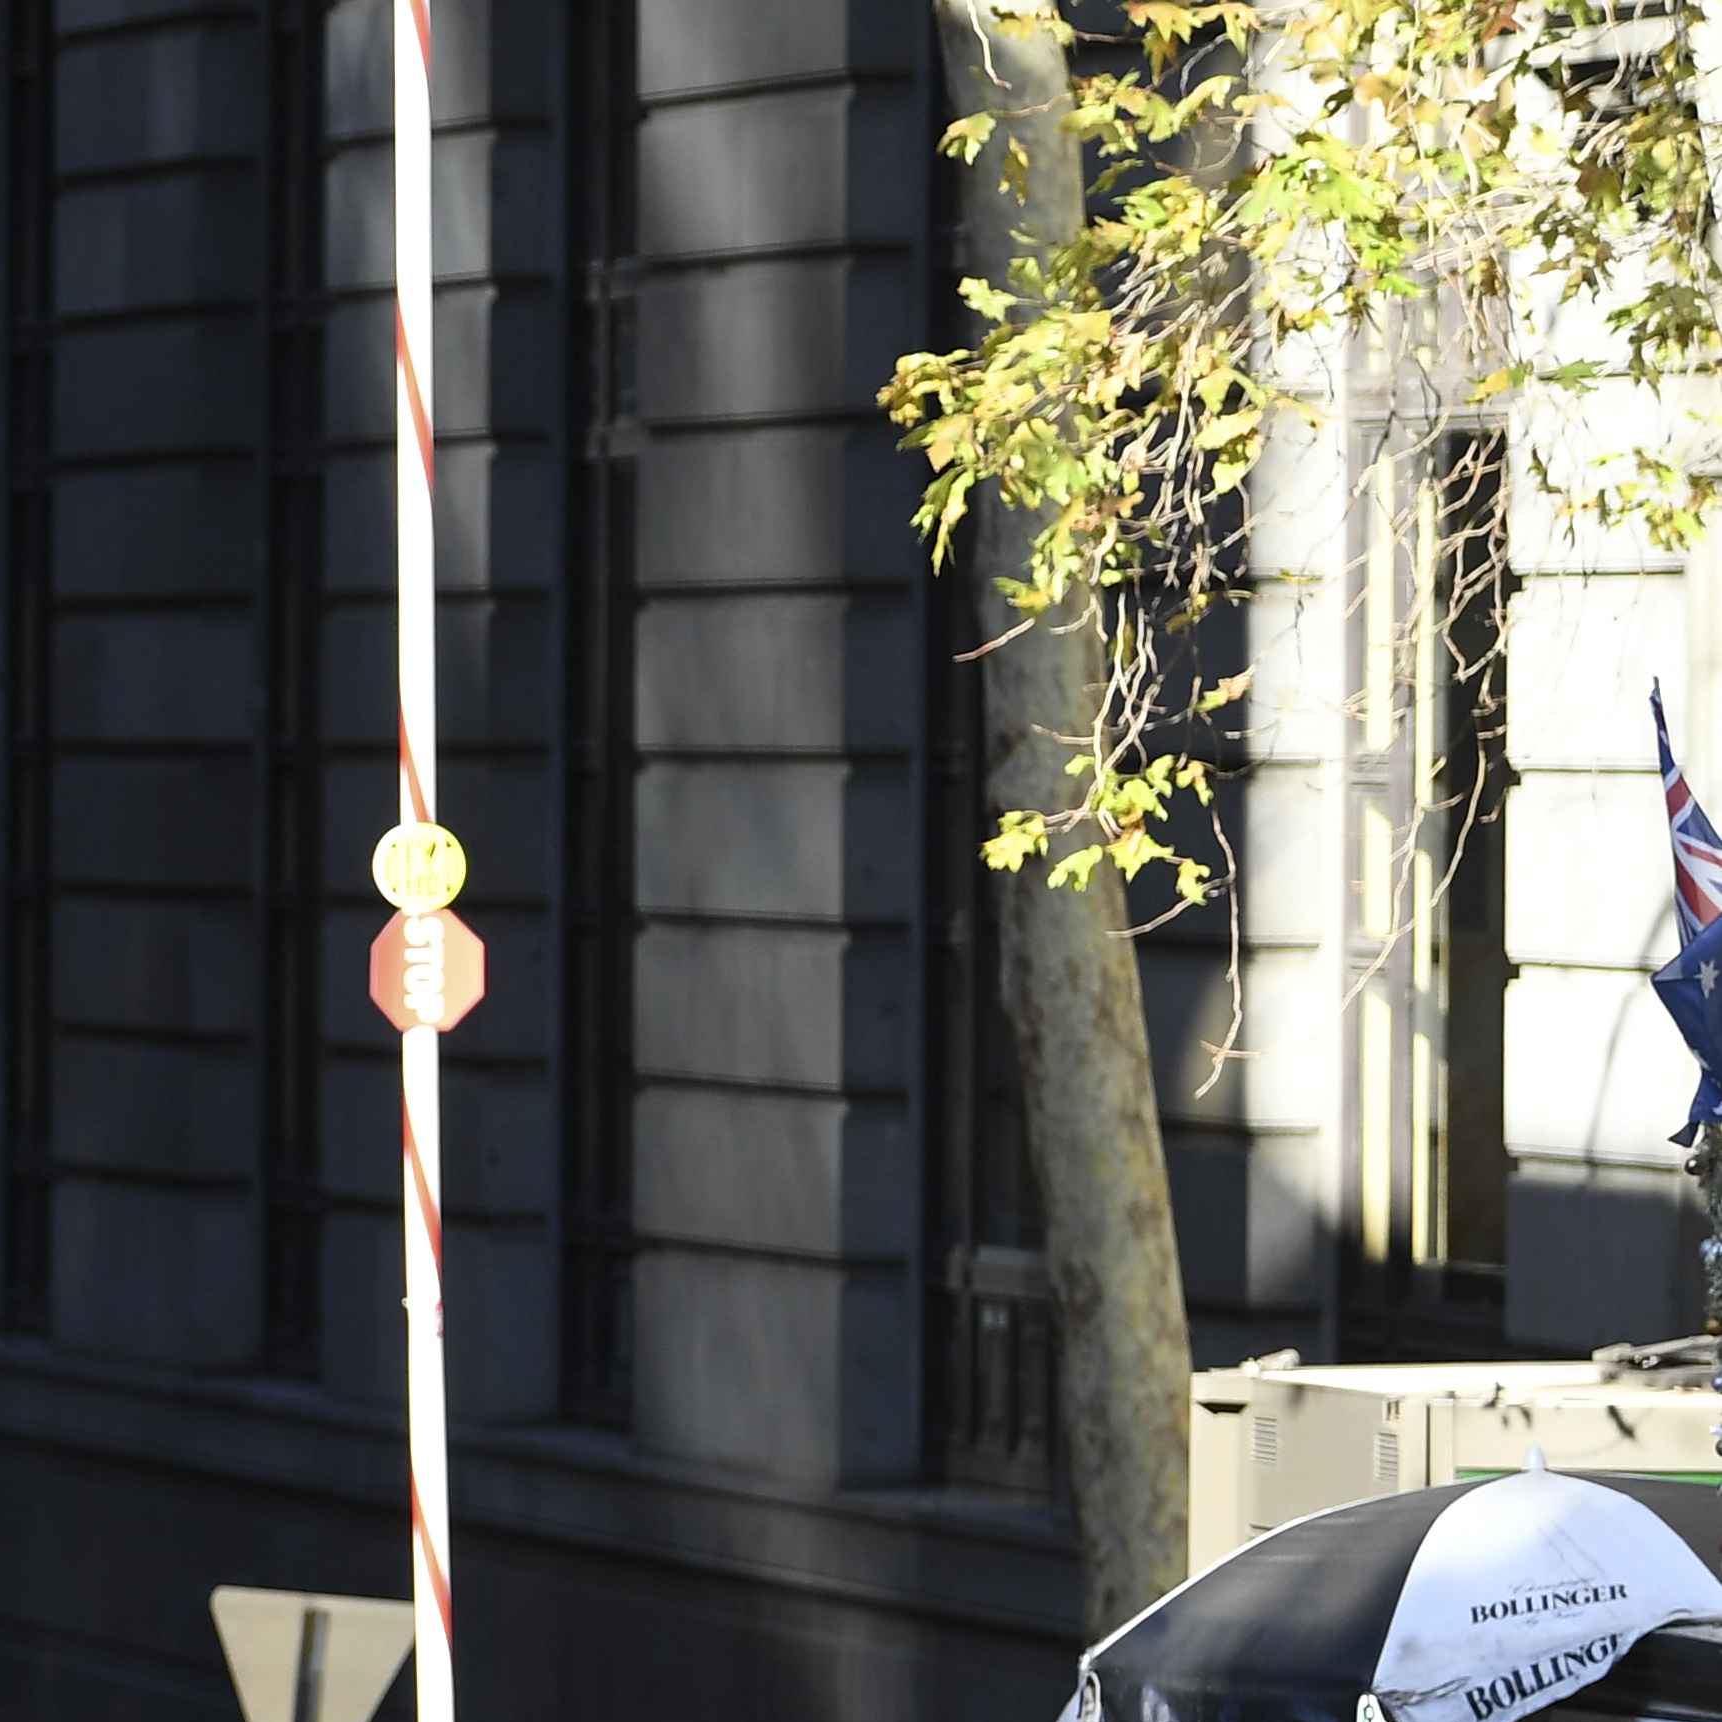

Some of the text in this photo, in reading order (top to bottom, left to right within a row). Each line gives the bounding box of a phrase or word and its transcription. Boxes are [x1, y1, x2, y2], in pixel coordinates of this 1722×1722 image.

[404, 916, 445, 1024] STOP
[1470, 1583, 1628, 1625] BOLLINGER
[1465, 1632, 1624, 1722] BOLLING
